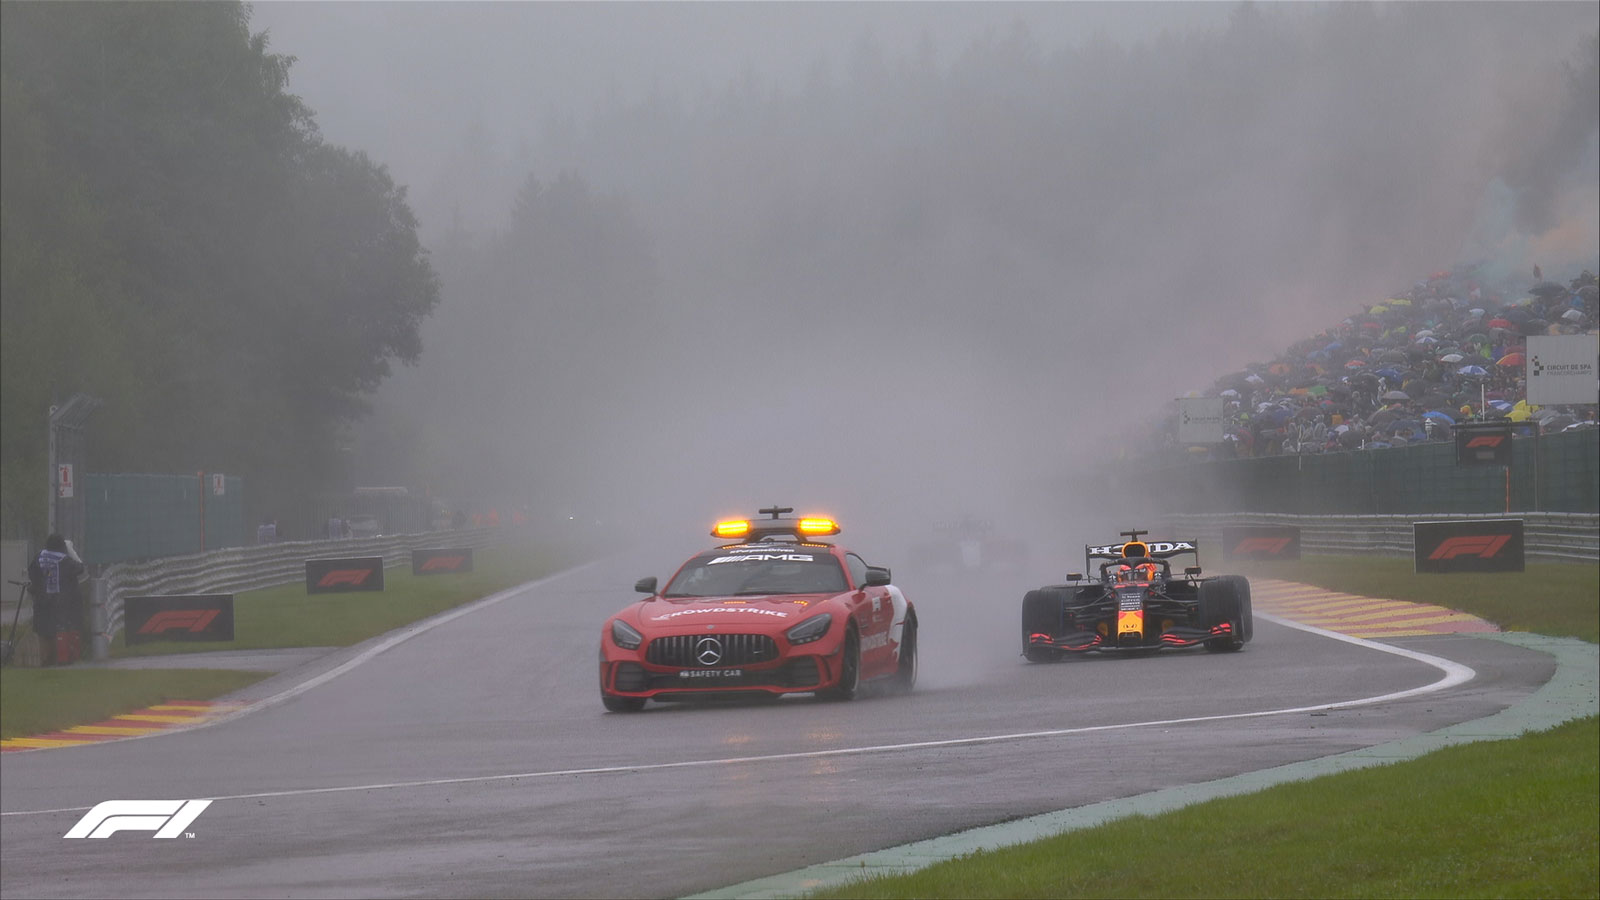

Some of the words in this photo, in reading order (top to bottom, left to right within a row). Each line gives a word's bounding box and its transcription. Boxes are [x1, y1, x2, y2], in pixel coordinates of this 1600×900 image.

[1466, 436, 1505, 448] F1
[1231, 537, 1293, 554] F1
[1428, 535, 1512, 560] F1
[420, 556, 465, 571] F1
[741, 554, 814, 562] AMG
[317, 569, 373, 587] F1
[137, 609, 221, 634] F1
[690, 670, 721, 678] SAFETY
